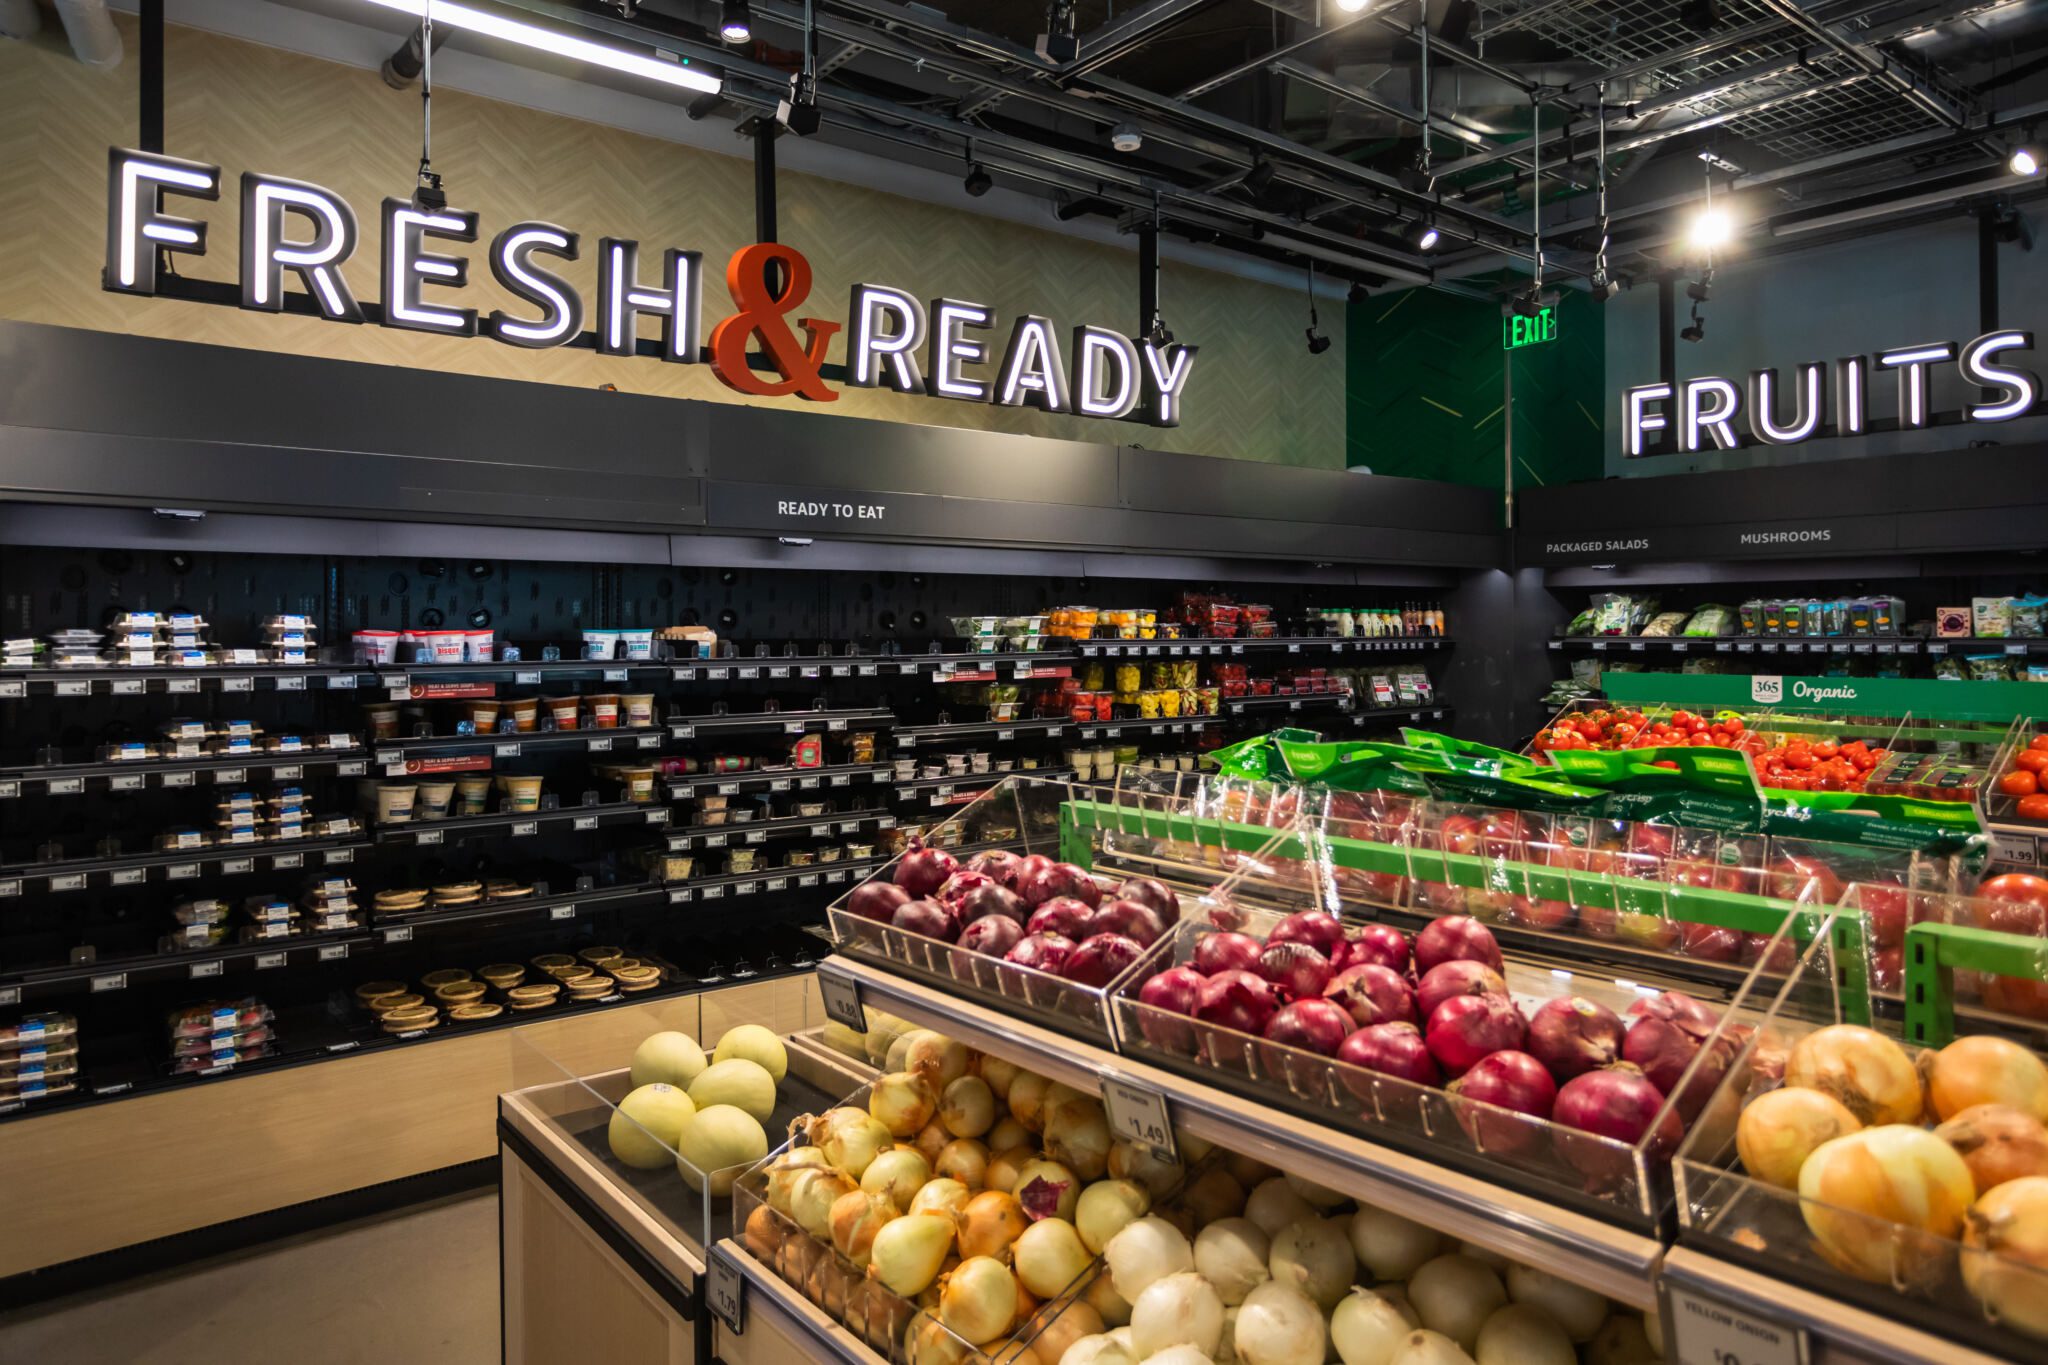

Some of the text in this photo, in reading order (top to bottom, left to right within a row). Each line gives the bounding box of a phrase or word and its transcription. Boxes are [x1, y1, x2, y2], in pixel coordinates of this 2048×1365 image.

[105, 146, 1199, 428] FRESH & READY
[1512, 308, 1551, 347] EXIT
[1622, 329, 2043, 458] FRUITS
[778, 501, 885, 519] READY TO EAT
[1546, 539, 1649, 553] PACKAGED SALADS
[1740, 529, 1832, 545] MUSHROOMS
[1755, 680, 1858, 702] 365 Organic
[1128, 1116, 1164, 1145] $1.49
[717, 1287, 736, 1315] $1.79
[1684, 1299, 1780, 1345] YELLOW ONION
